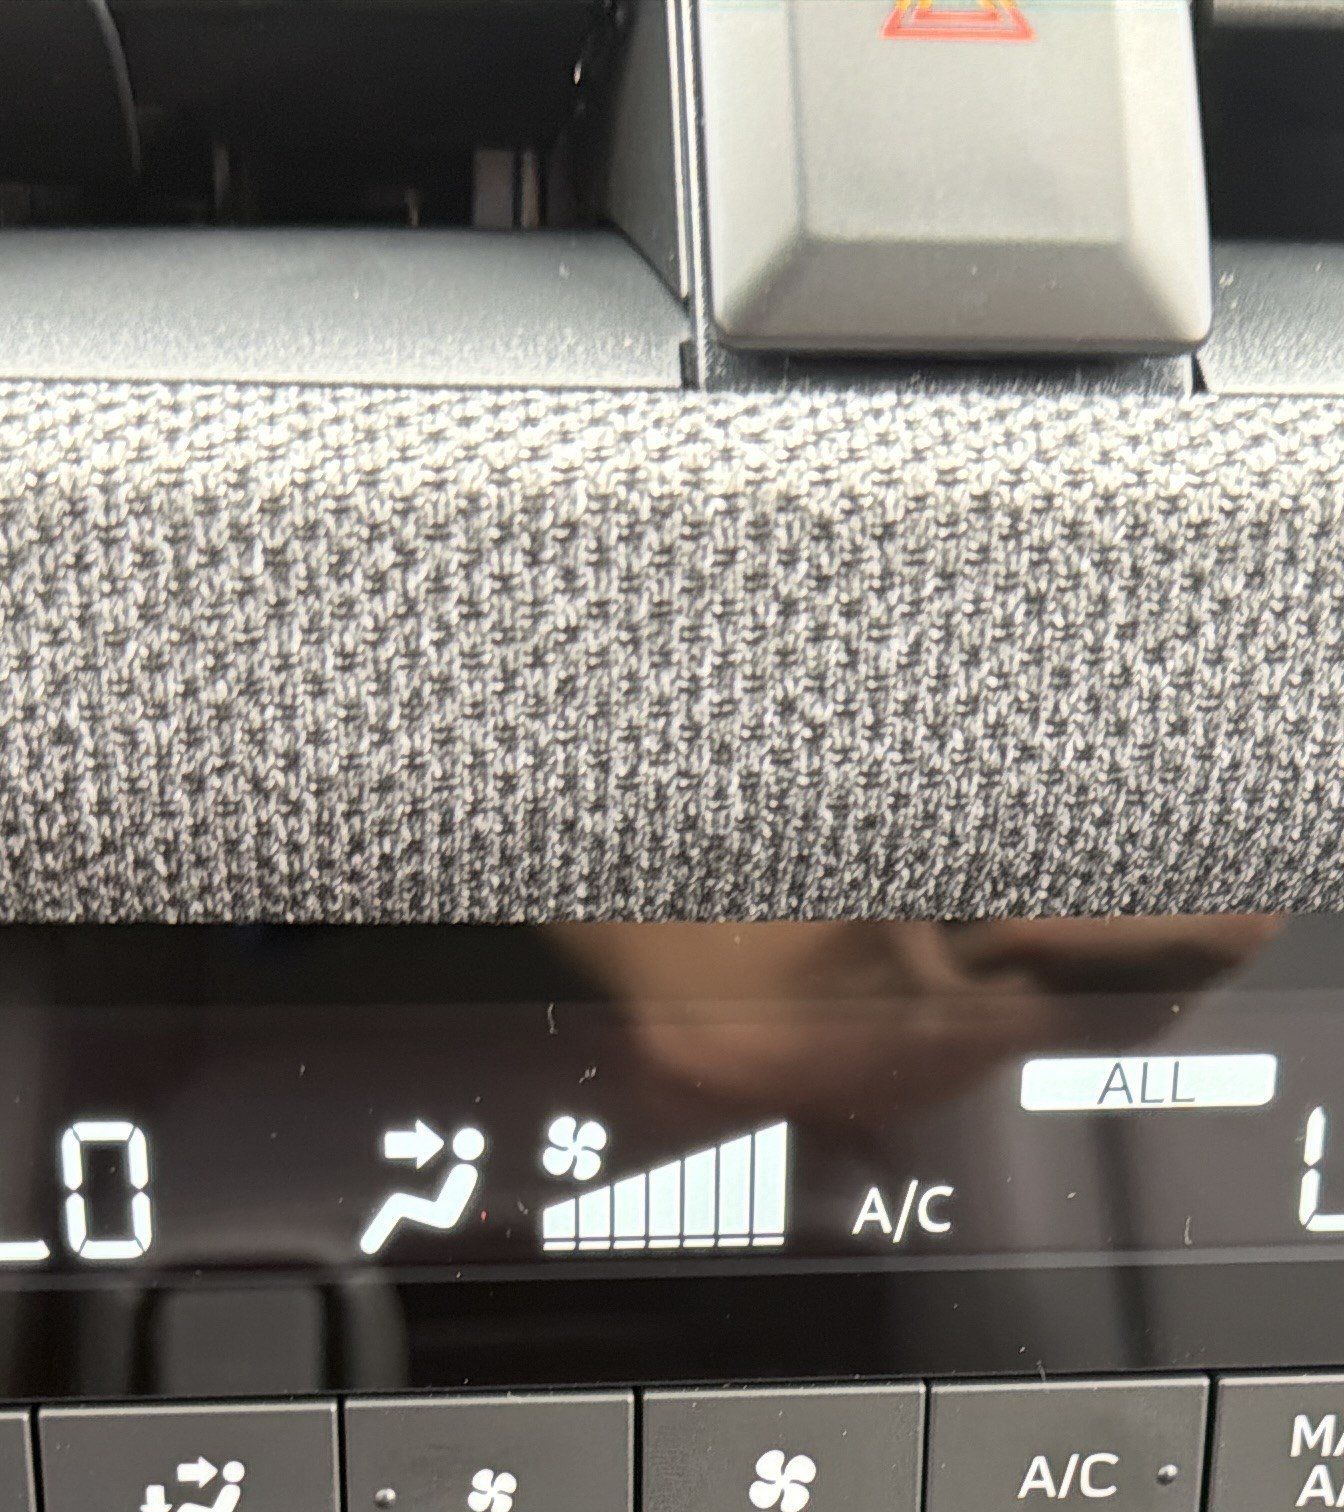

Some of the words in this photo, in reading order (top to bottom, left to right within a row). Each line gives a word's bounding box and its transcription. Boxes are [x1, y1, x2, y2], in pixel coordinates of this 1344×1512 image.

[1097, 1061, 1196, 1104] ALL
[852, 1179, 954, 1243] A/C
[1018, 1453, 1119, 1500] A/C
